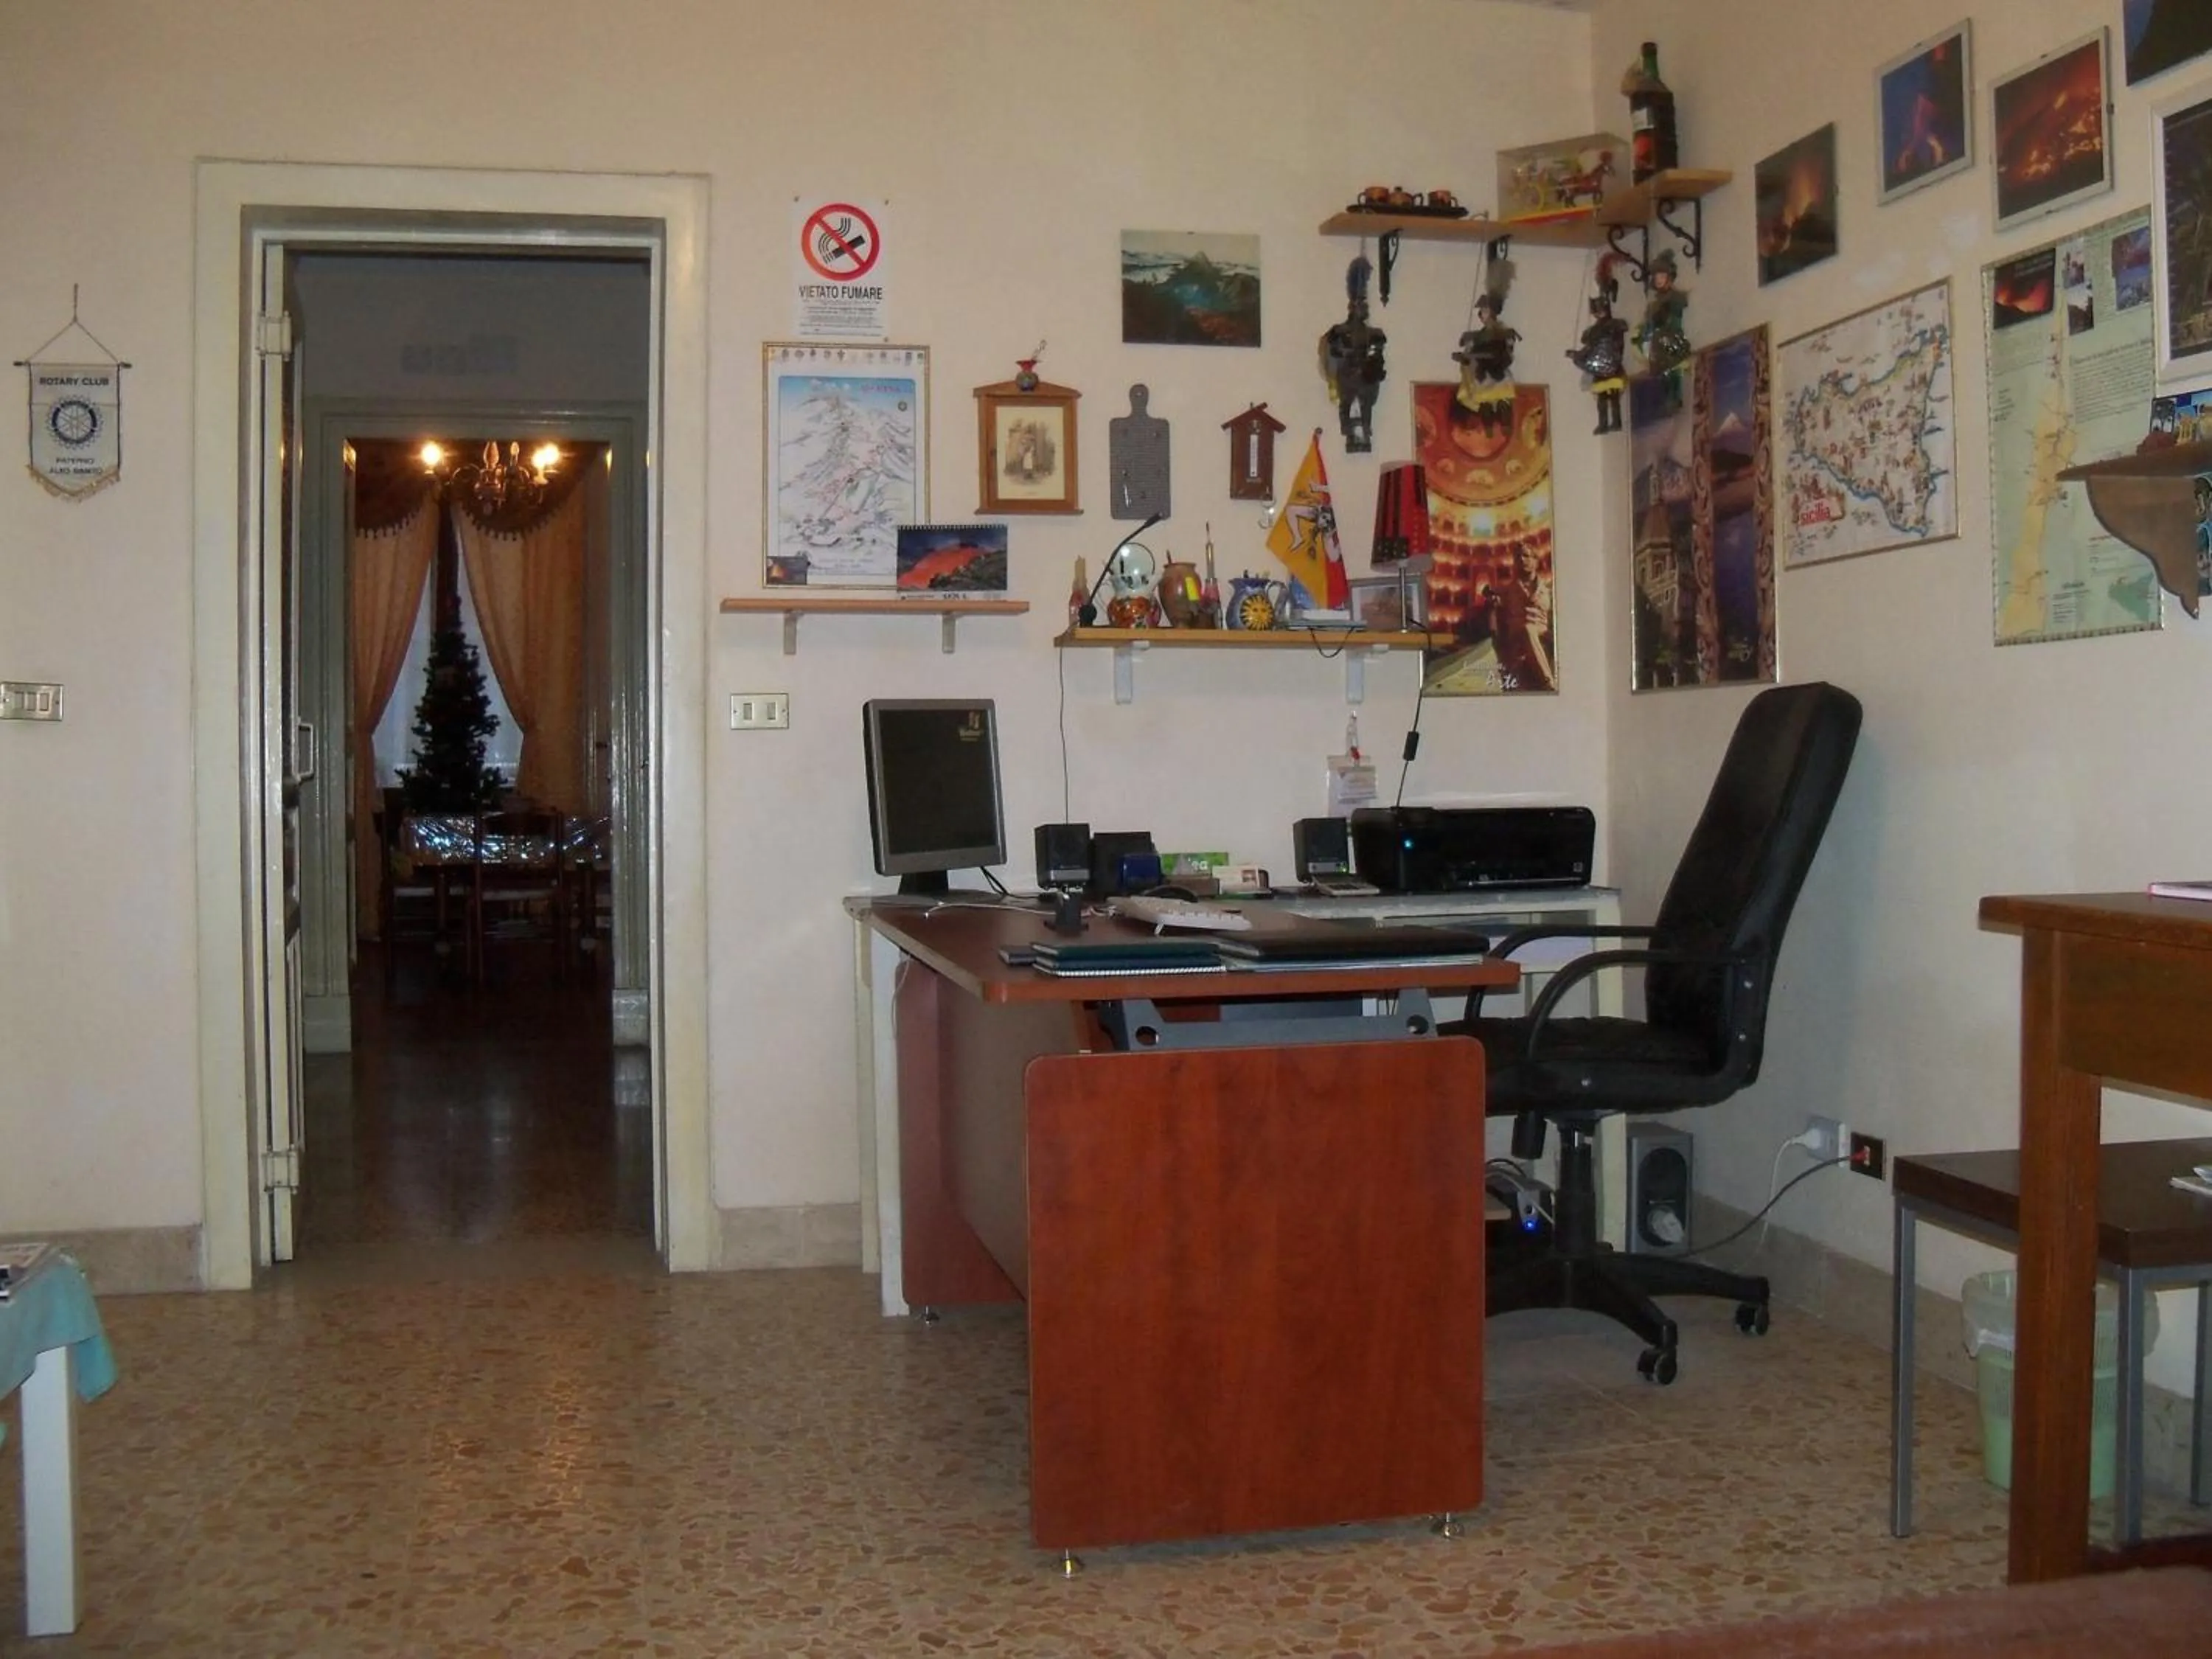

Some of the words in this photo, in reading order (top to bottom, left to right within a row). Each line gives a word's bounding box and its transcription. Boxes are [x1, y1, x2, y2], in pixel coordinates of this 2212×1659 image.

[799, 285, 839, 299] VIETATO
[841, 286, 883, 300] FUMARE
[40, 377, 79, 386] ROTARY
[82, 377, 109, 386] CLUB
